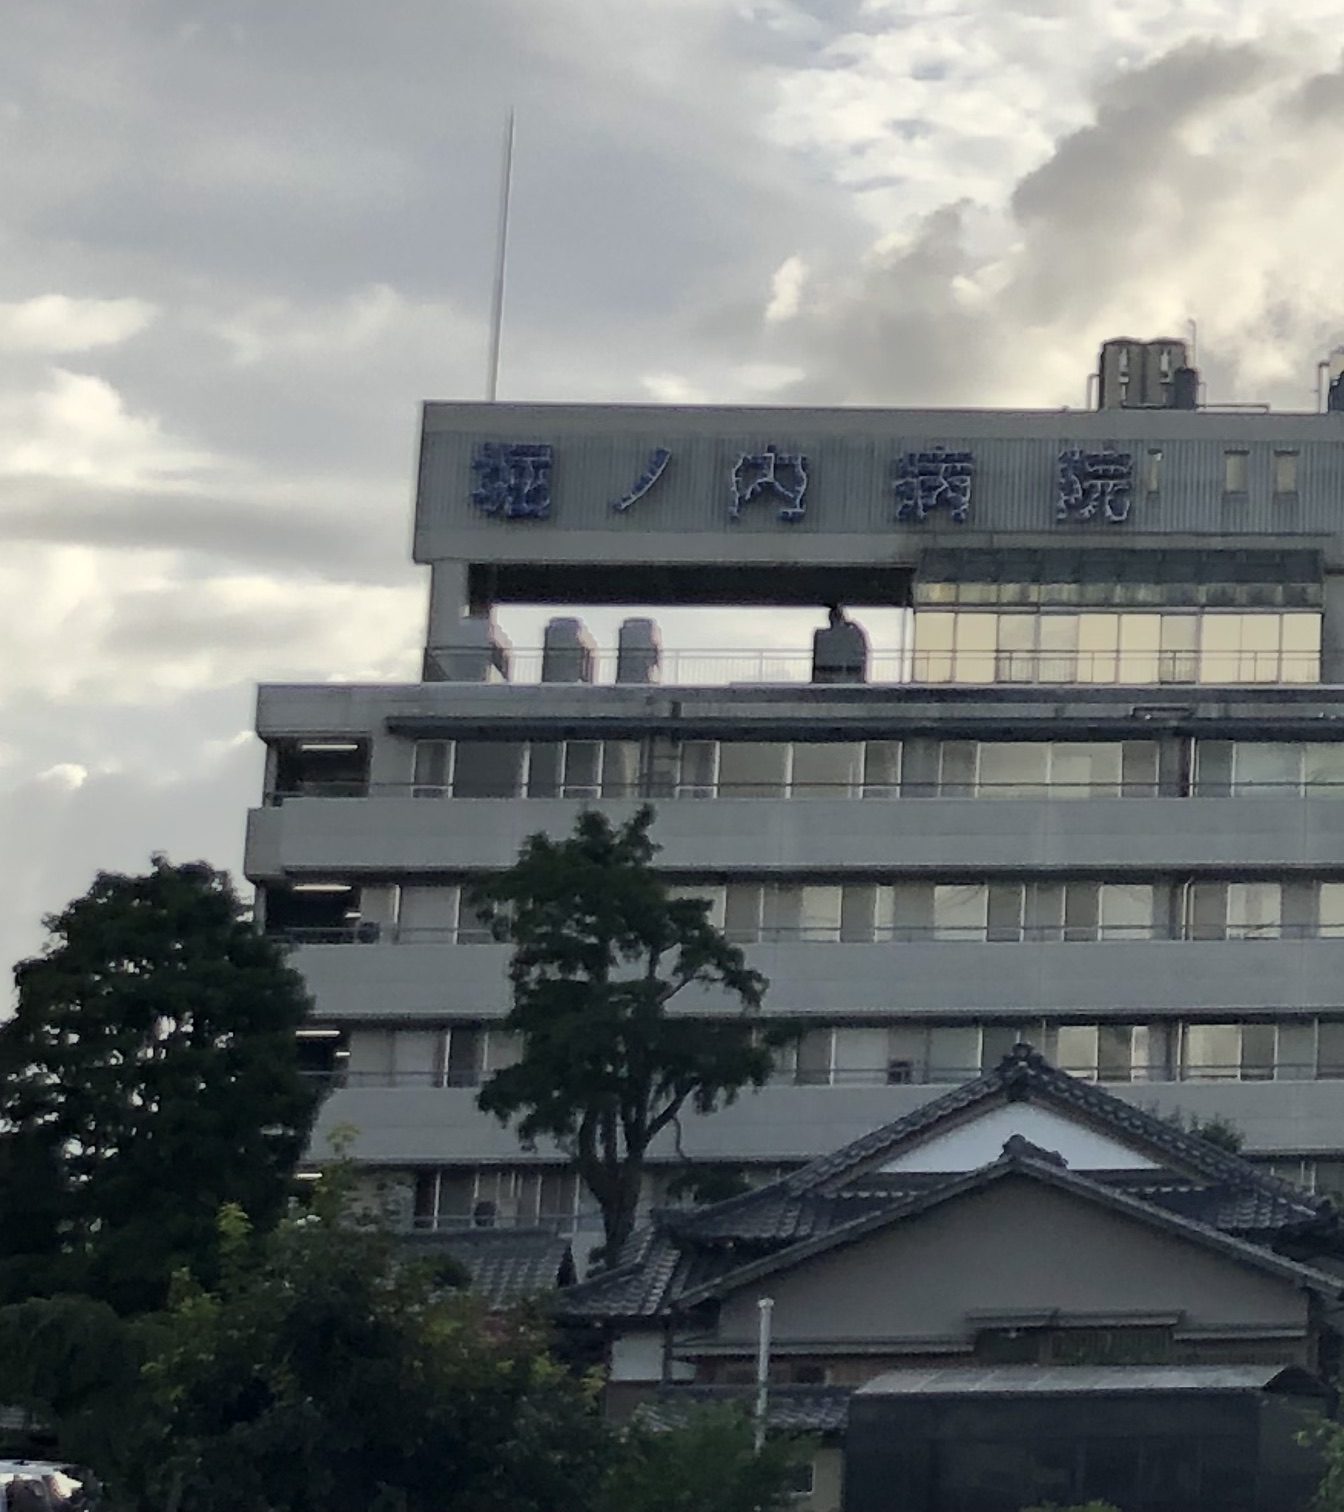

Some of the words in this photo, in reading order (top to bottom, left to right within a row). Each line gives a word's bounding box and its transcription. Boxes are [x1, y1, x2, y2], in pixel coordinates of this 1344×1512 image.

[471, 442, 1133, 524] 堀ノ内病院
